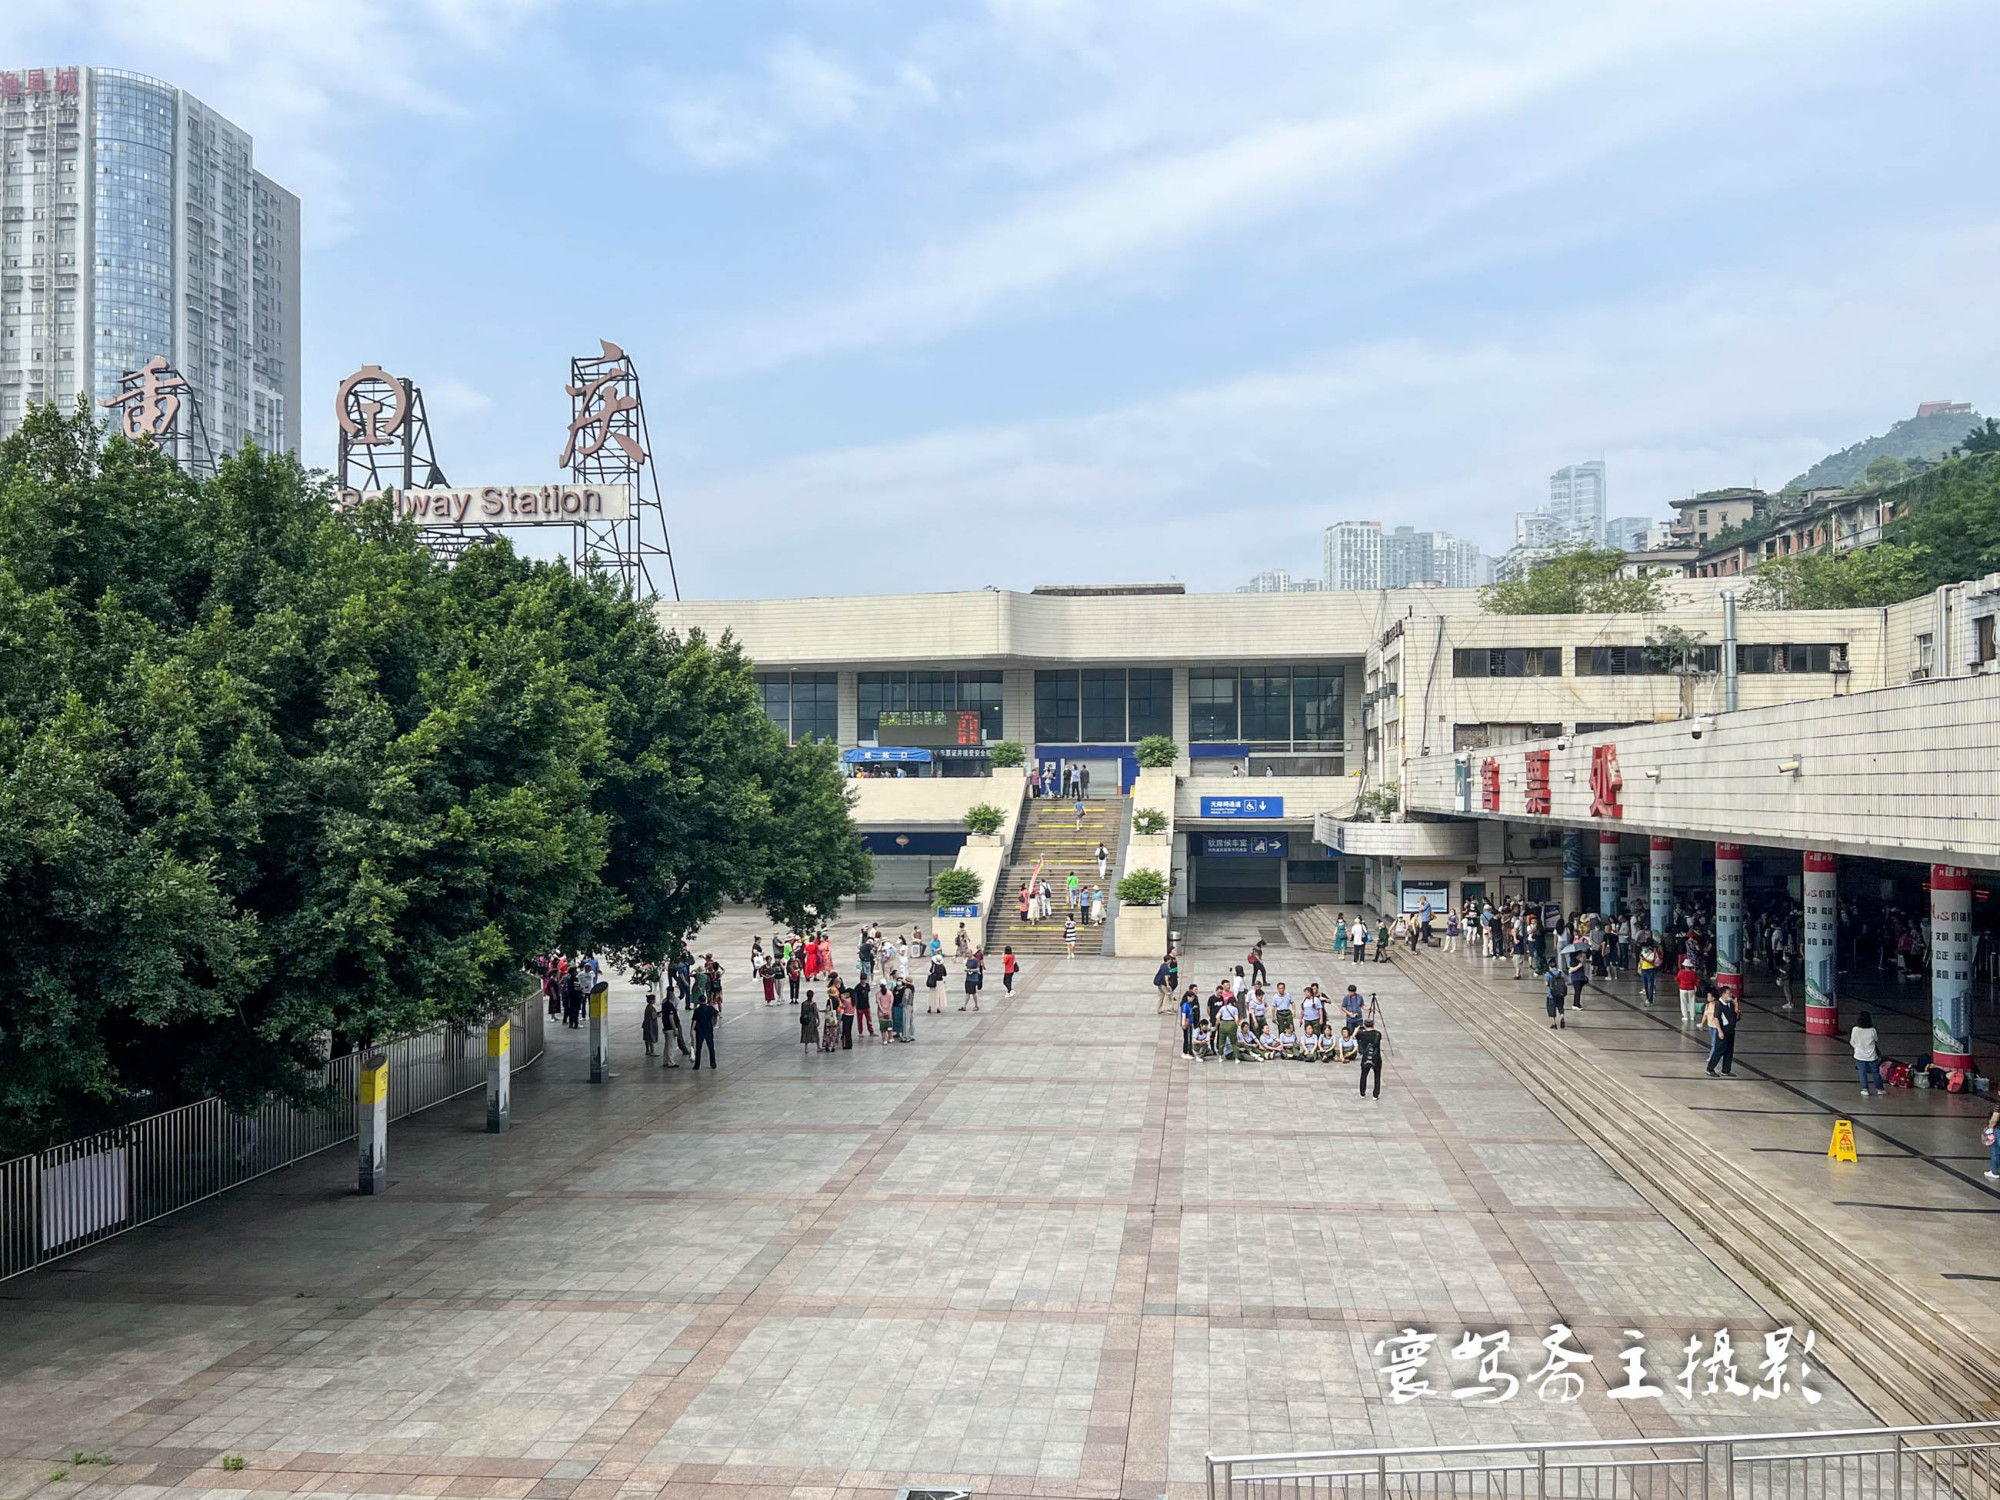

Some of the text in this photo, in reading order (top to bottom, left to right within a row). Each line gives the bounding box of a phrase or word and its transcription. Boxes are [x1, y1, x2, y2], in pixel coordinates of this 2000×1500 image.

[559, 338, 645, 468] 庆
[338, 485, 602, 523] Rlway Station
[1480, 744, 1623, 819] 售票处
[1207, 839, 1247, 847] 软席候车室
[1936, 932, 1949, 941] 文明
[1936, 950, 1949, 960] 公正
